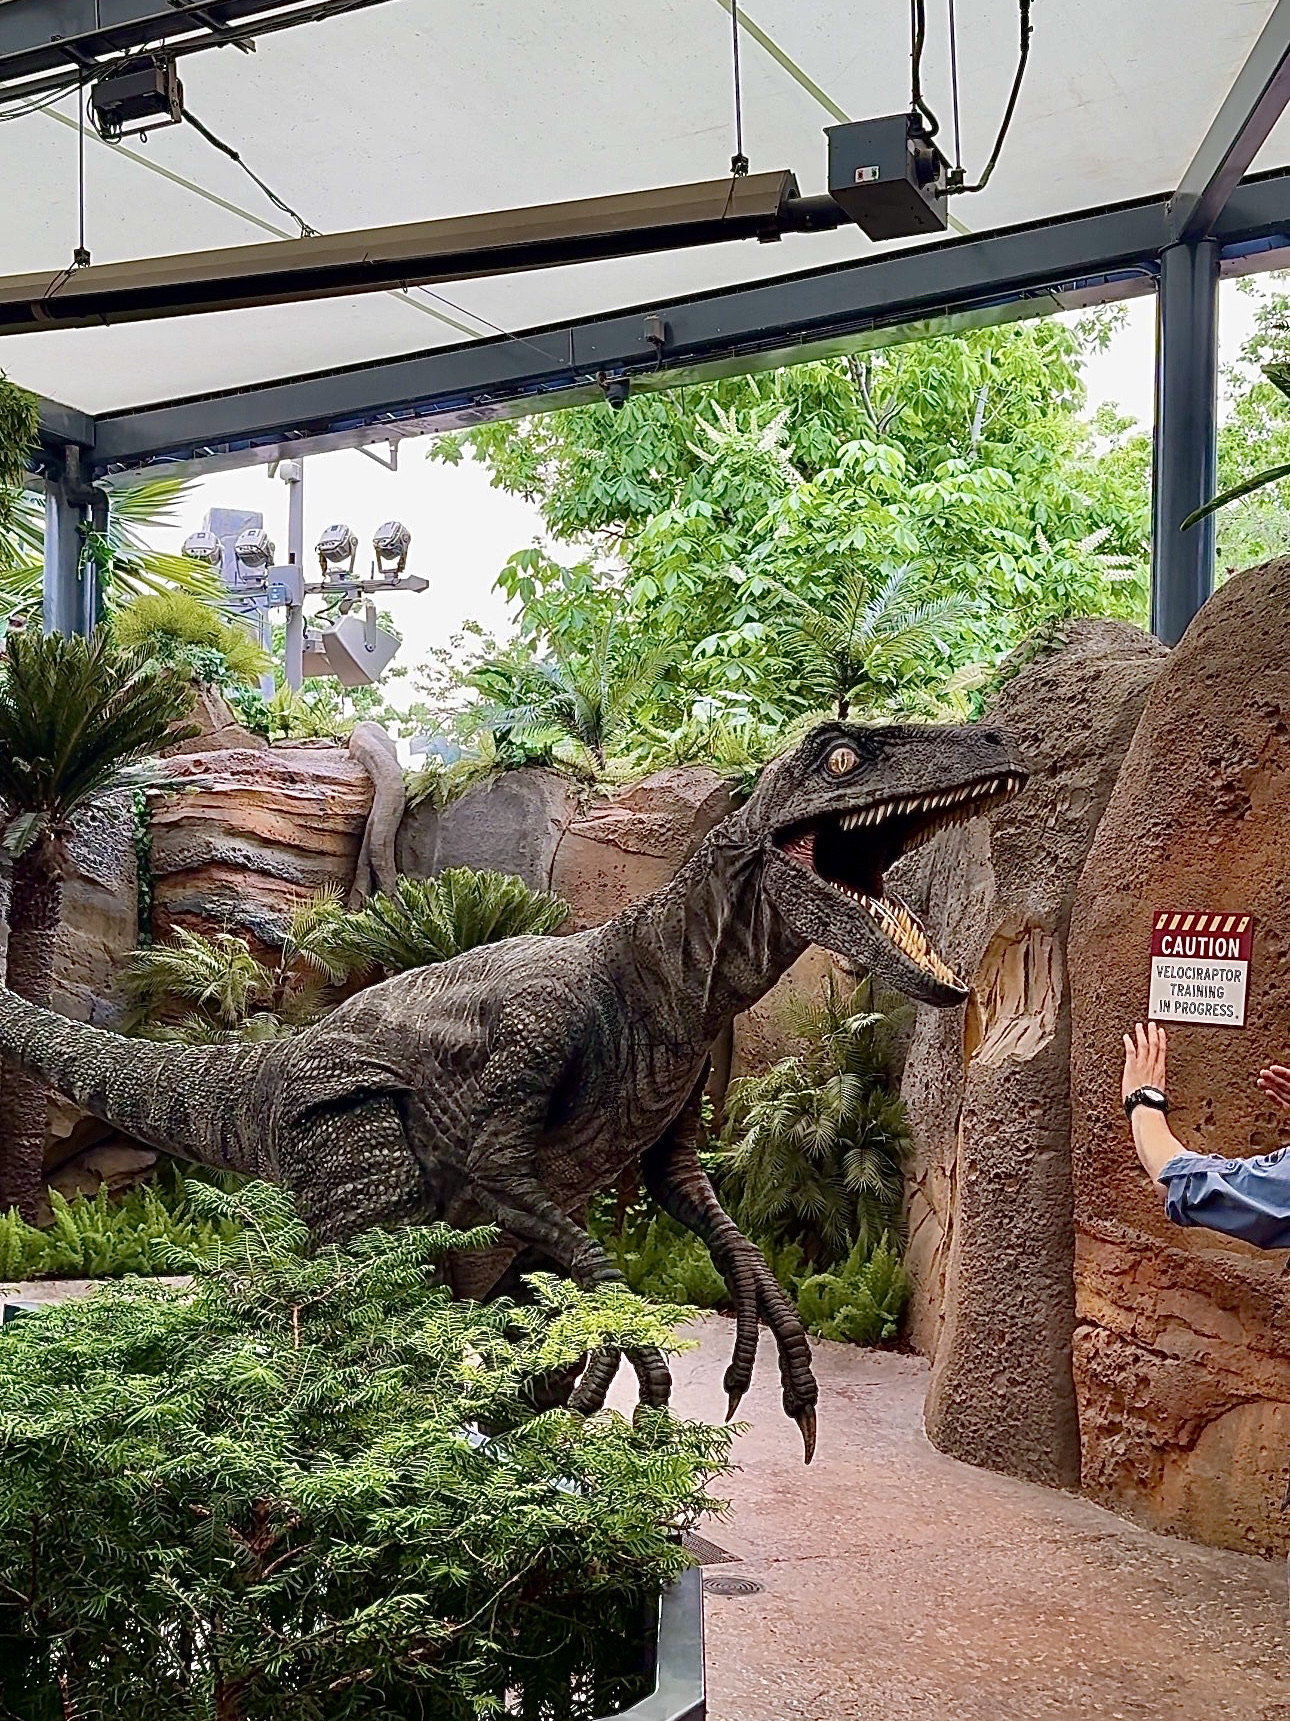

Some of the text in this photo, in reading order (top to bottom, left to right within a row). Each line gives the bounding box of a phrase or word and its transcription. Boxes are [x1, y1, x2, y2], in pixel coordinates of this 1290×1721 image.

[1161, 936, 1240, 958] CAUTION
[1156, 965, 1242, 983] VELOCIRAPTOR
[1170, 983, 1225, 999] TRAINING
[1159, 999, 1234, 1018] IN PROGRESS
